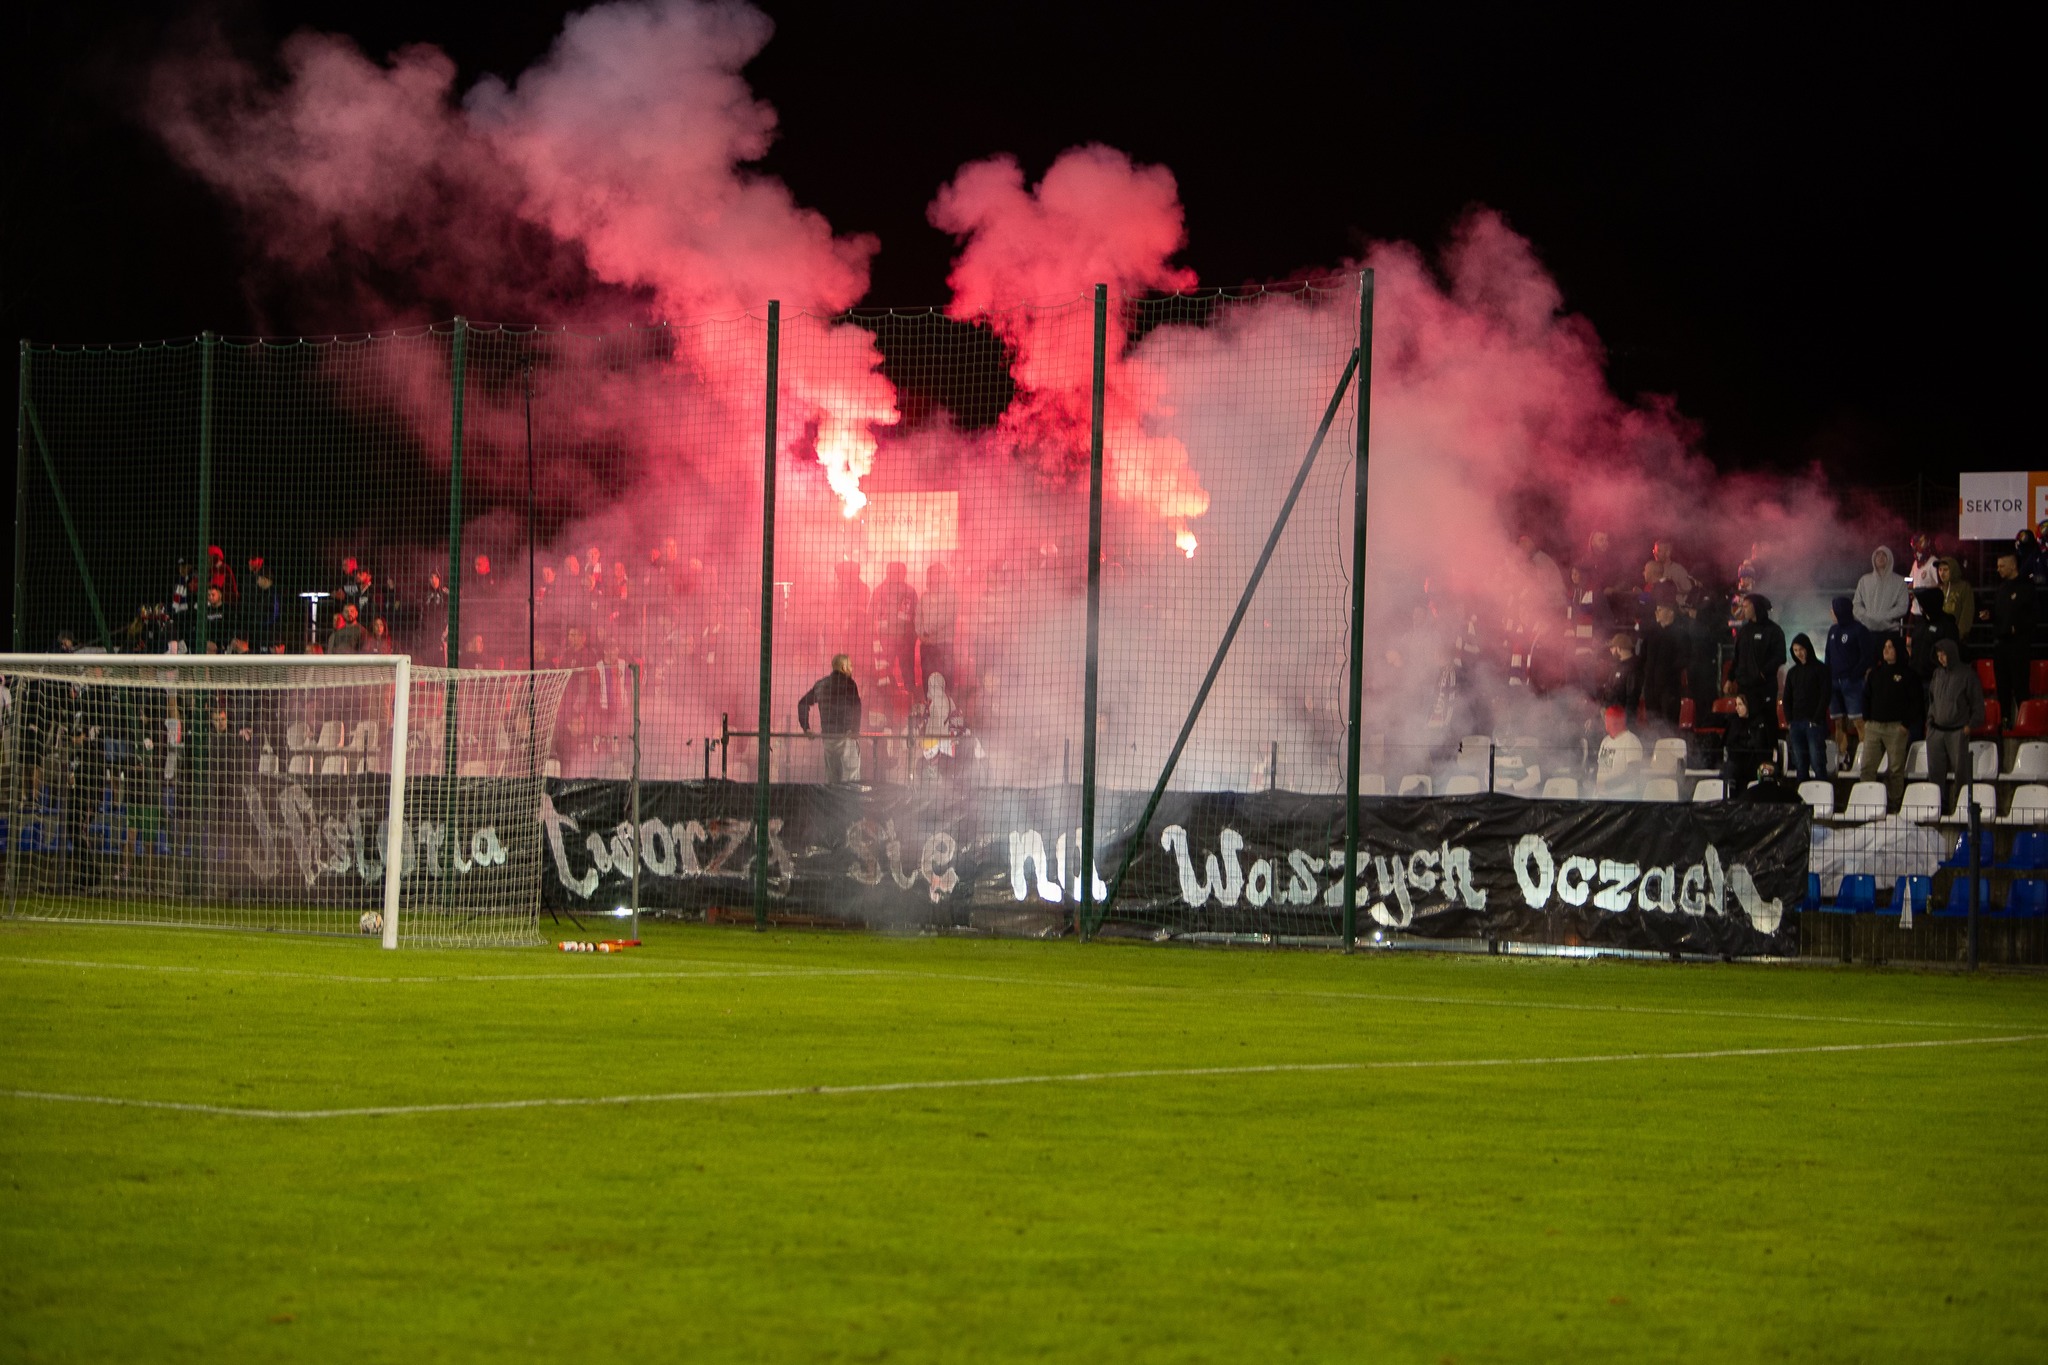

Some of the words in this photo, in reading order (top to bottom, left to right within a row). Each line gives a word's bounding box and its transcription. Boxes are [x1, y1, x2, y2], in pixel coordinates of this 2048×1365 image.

[1966, 499, 2023, 513] SEKTOR
[871, 515, 914, 527] SEKTOR
[1160, 824, 1487, 928] Waszych
[1513, 833, 1784, 935] Oczach
